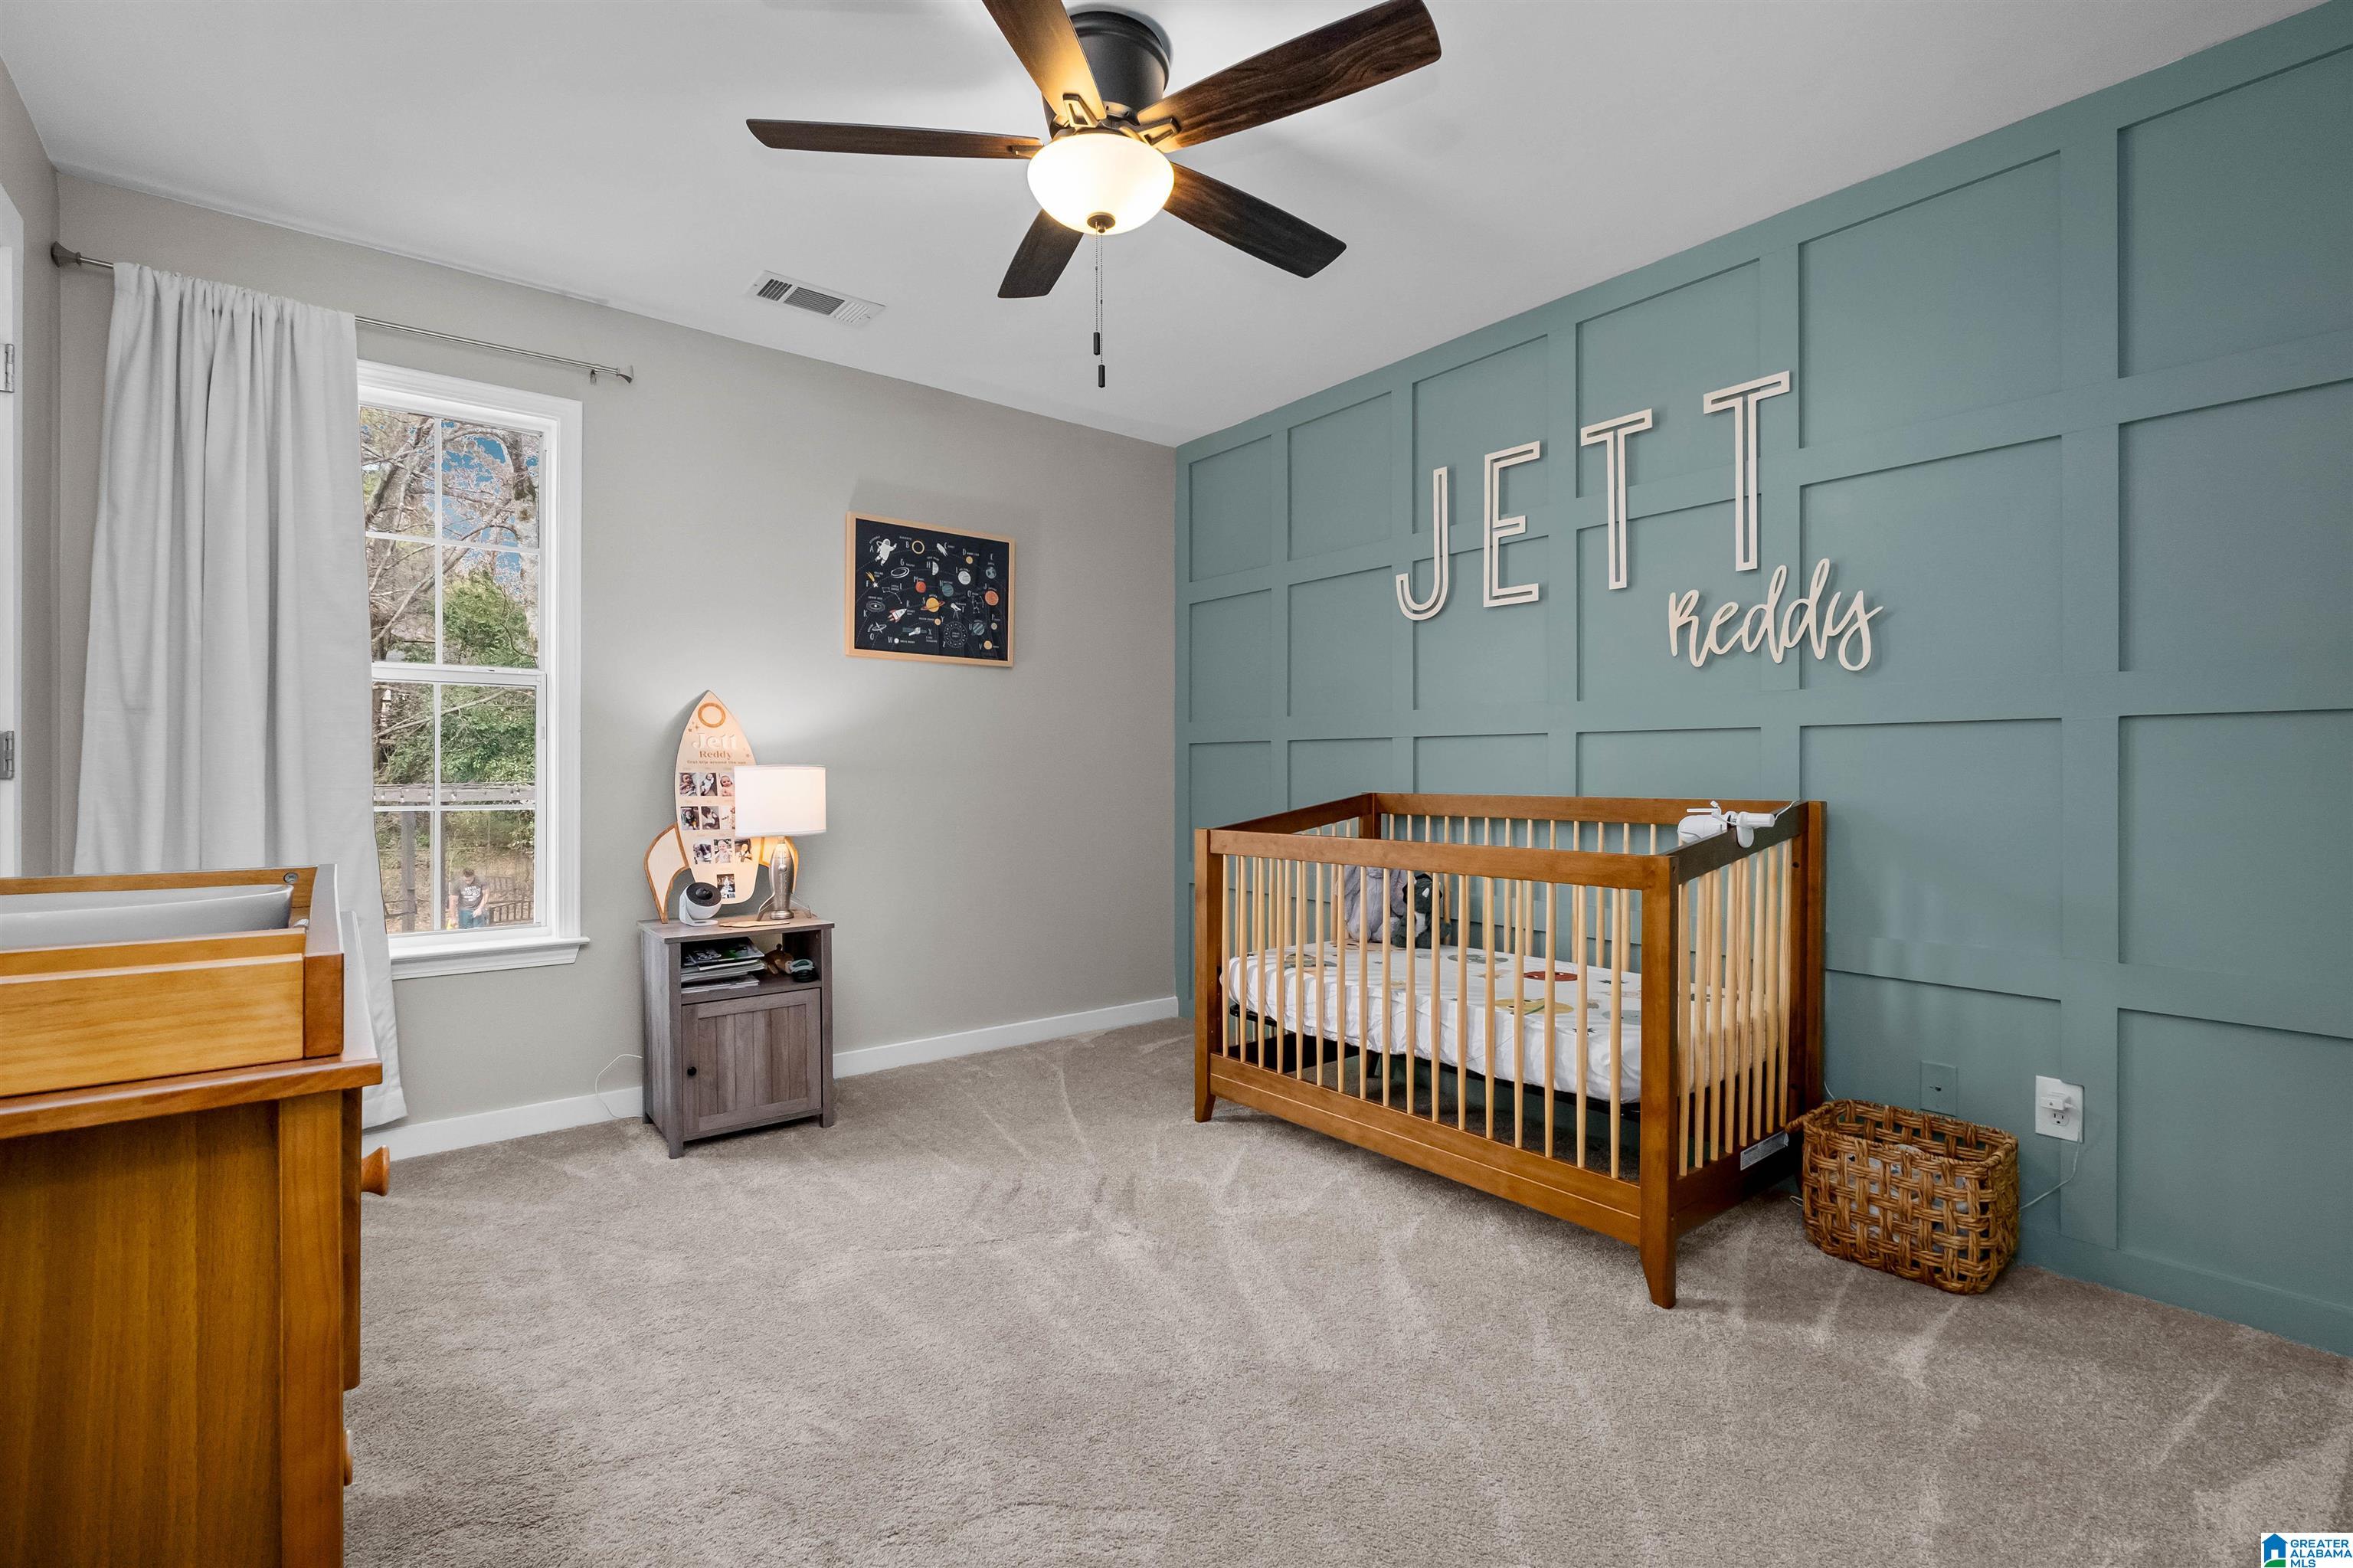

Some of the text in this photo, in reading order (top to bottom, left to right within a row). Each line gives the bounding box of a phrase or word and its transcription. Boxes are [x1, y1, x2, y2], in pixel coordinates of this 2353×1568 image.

[1396, 370, 1791, 621] JETT
[1669, 558, 1883, 671] Reddy
[692, 732, 737, 749] Jett
[699, 751, 732, 760] Reddy
